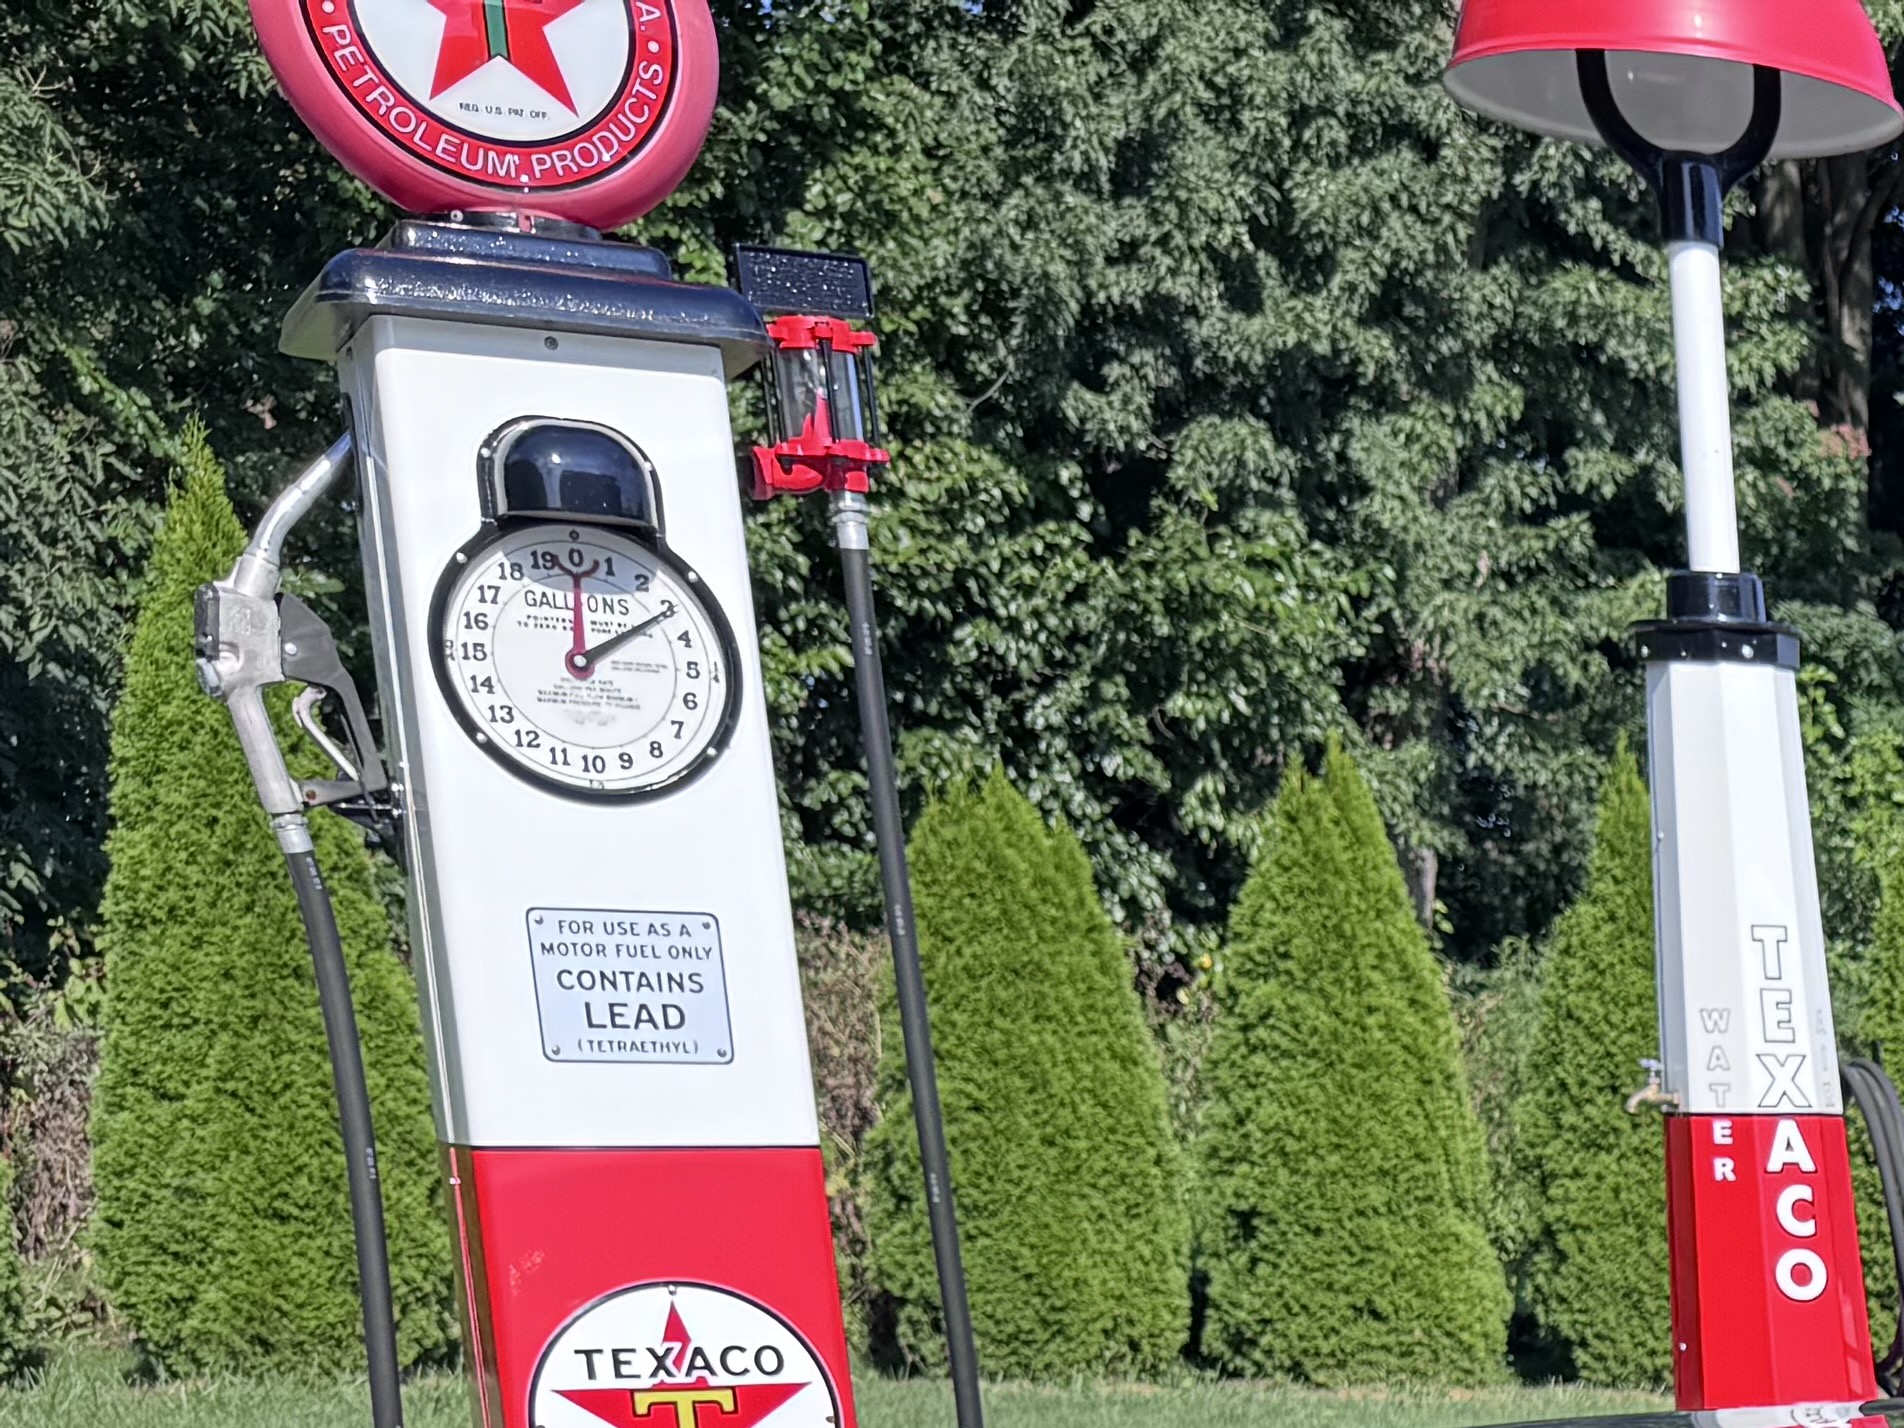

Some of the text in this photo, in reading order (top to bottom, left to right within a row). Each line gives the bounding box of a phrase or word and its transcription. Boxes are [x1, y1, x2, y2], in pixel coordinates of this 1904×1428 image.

[322, 24, 663, 180] PETROLEUM PRODUCTS
[530, 550, 556, 570] 19
[568, 548, 584, 567] 0
[604, 556, 616, 577] 1
[498, 562, 524, 581] 18
[634, 574, 650, 592] 2
[477, 585, 501, 605] 17
[463, 611, 489, 630] 16
[677, 629, 693, 648] 4
[461, 643, 487, 661] 15
[685, 661, 701, 679] 5
[470, 675, 495, 694] 14
[682, 692, 698, 710] 6
[488, 705, 514, 723] 13
[515, 730, 541, 748] 12
[671, 720, 684, 739] 7
[549, 747, 571, 766] 11
[649, 741, 664, 759] 8
[581, 755, 605, 773] 10
[618, 752, 634, 770] 9
[558, 920, 692, 937] FOR USE AS A
[540, 942, 713, 960] MOTOR FUEL ONLY
[556, 969, 704, 994] CONTAINS
[584, 1001, 686, 1031] LEAD
[577, 1038, 698, 1054] (TETRAETHYL)
[1700, 1007, 1737, 1183] WATER
[1750, 923, 1829, 1303] TEXACO
[573, 1344, 785, 1380] TEXACO
